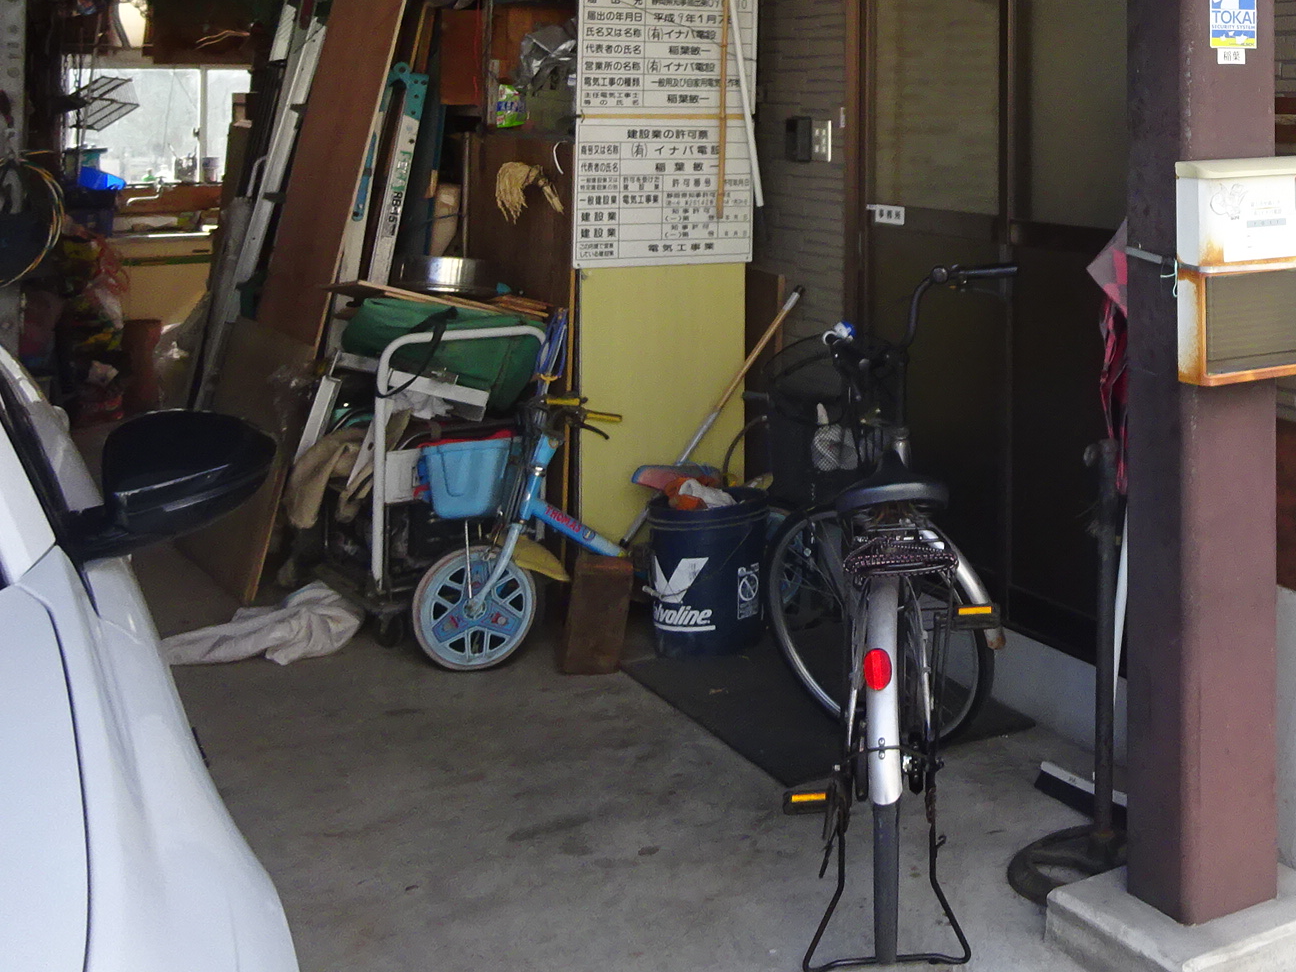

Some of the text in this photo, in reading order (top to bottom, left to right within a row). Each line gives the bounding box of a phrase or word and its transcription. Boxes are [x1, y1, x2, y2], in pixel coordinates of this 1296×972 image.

[587, 11, 643, 22] 届出の年月日
[1211, 10, 1256, 24] TOKAI
[586, 27, 642, 38] 氏名又は名称
[585, 45, 642, 55] 代表者の氏名
[585, 61, 641, 71] 営業所の名称
[584, 77, 640, 87] 電気工事の種類
[626, 129, 709, 140] 建設業の許可票
[580, 162, 618, 173] 代表者の氏名
[622, 194, 659, 204] 電気工事業
[648, 242, 715, 252] 電気工事業
[545, 506, 583, 533] THOMAS
[653, 602, 713, 625] lvoline
